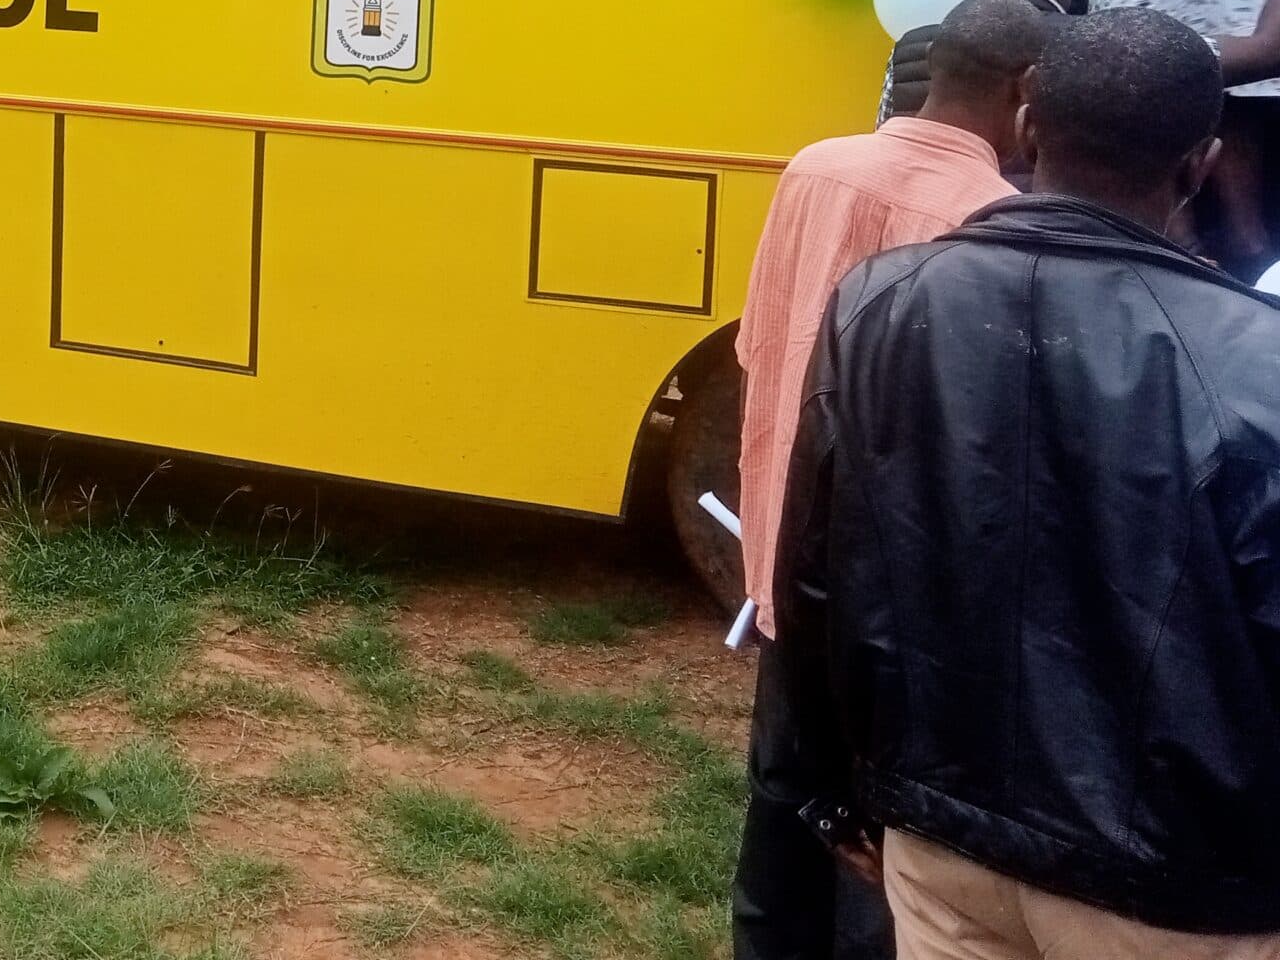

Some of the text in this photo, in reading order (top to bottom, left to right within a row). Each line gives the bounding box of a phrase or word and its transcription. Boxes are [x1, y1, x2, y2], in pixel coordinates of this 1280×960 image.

[336, 29, 409, 62] DISCIPLINE FOR EXCELLENCE
